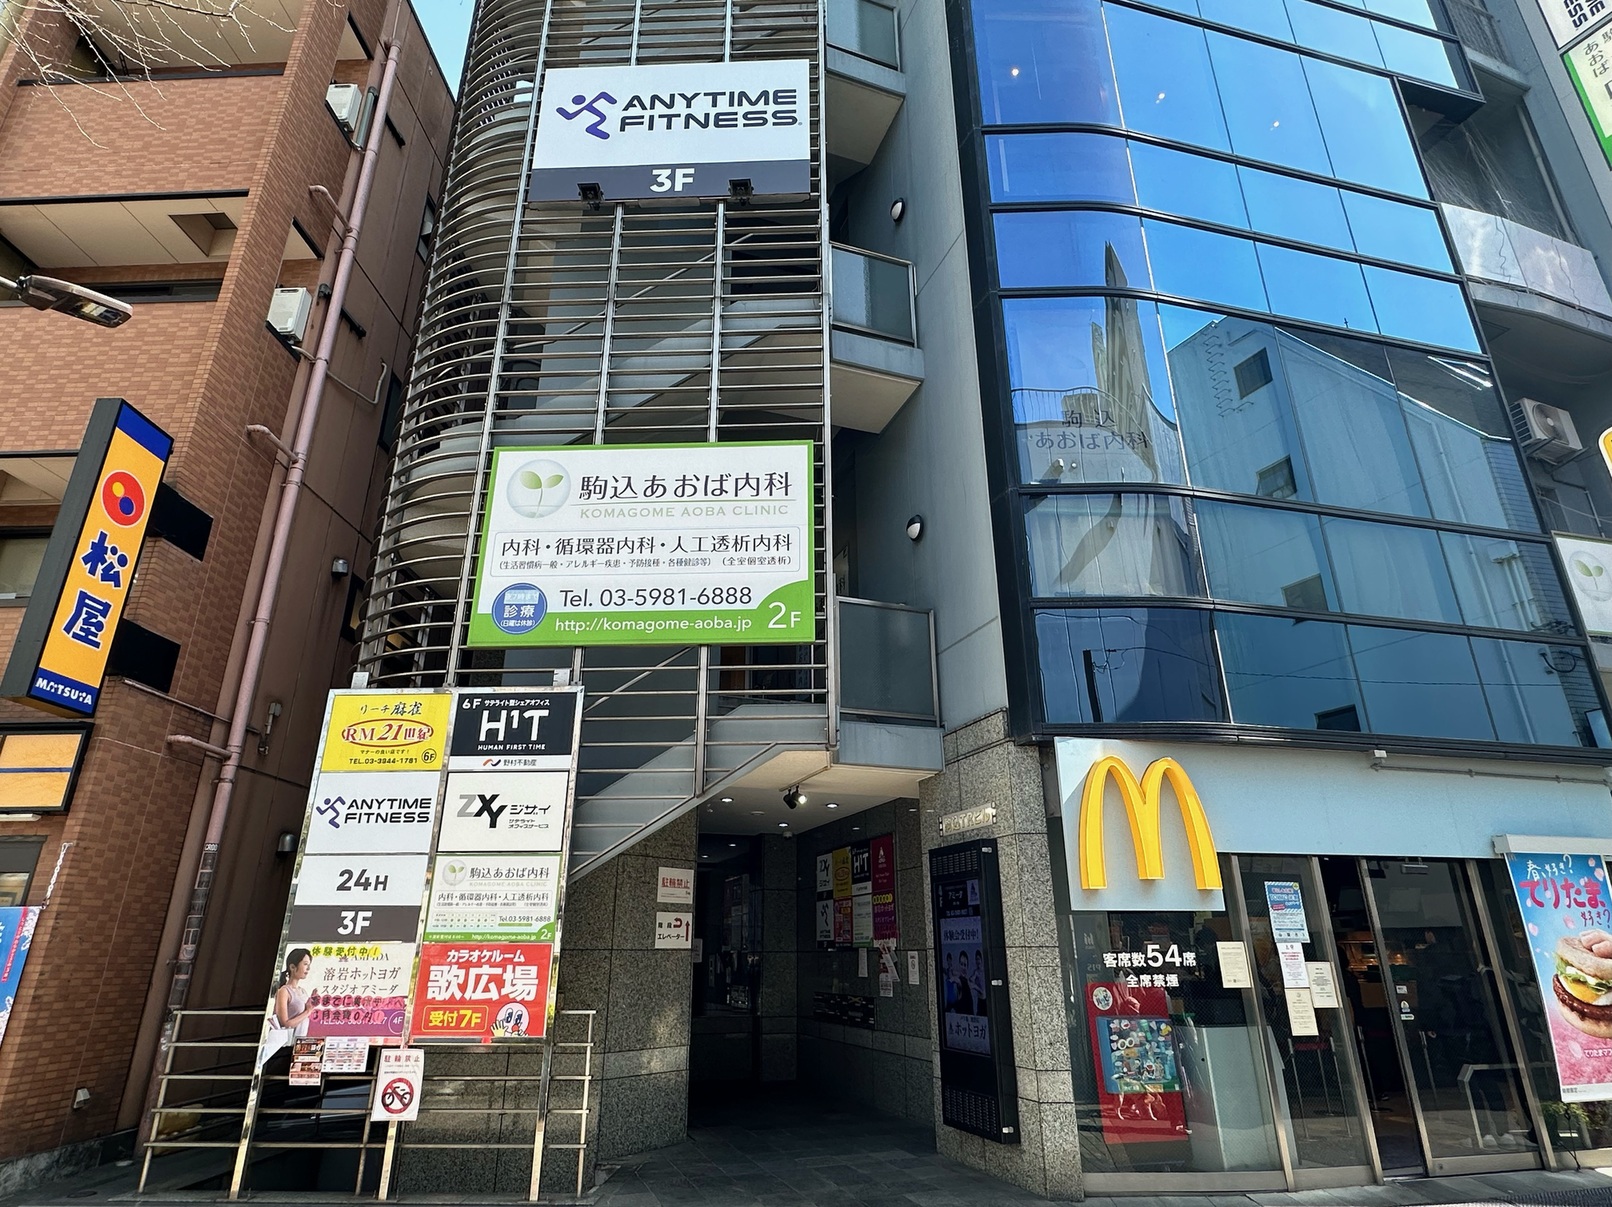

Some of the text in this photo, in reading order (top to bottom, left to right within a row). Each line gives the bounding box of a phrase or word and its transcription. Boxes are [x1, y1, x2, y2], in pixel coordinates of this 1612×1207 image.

[622, 88, 797, 111] ANYTIME
[619, 109, 799, 132] FITNESS
[650, 168, 695, 192] 3F
[1061, 410, 1117, 428] 駒込
[1035, 431, 1149, 450] あおば内科
[578, 472, 792, 500] 駒込あおば内科
[580, 504, 789, 519] KOMAGOME AOBA CLINIC
[501, 533, 793, 557] 内科・循環器内科・人工透析内科
[62, 529, 129, 650] 松屋
[560, 586, 752, 607] Tel. 03-5981-6888
[503, 604, 536, 618] 診療
[768, 601, 801, 628] 2F
[555, 616, 752, 634] http://komagome-aoba.jp
[35, 677, 93, 706] MATSUYA
[360, 701, 423, 716] リーチ麻雀
[462, 698, 481, 709] 6F
[423, 751, 435, 761] 6F
[347, 798, 432, 810] ANYTIME
[457, 794, 508, 828] ZXY
[344, 812, 431, 824] FITNESS
[336, 869, 389, 891] 24H
[469, 867, 550, 879] 駒込あおば内科
[337, 911, 373, 935] 3F
[541, 928, 552, 940] 2F
[447, 949, 526, 963] カラオケルーム
[1103, 944, 1197, 968] 客席数54席
[323, 967, 402, 981] 溶岩ホットヨガ
[426, 965, 539, 1002] 歌広場
[1126, 973, 1179, 988] 全席禁煙
[392, 1016, 403, 1025] 4F
[428, 1009, 483, 1028] 受付7F
